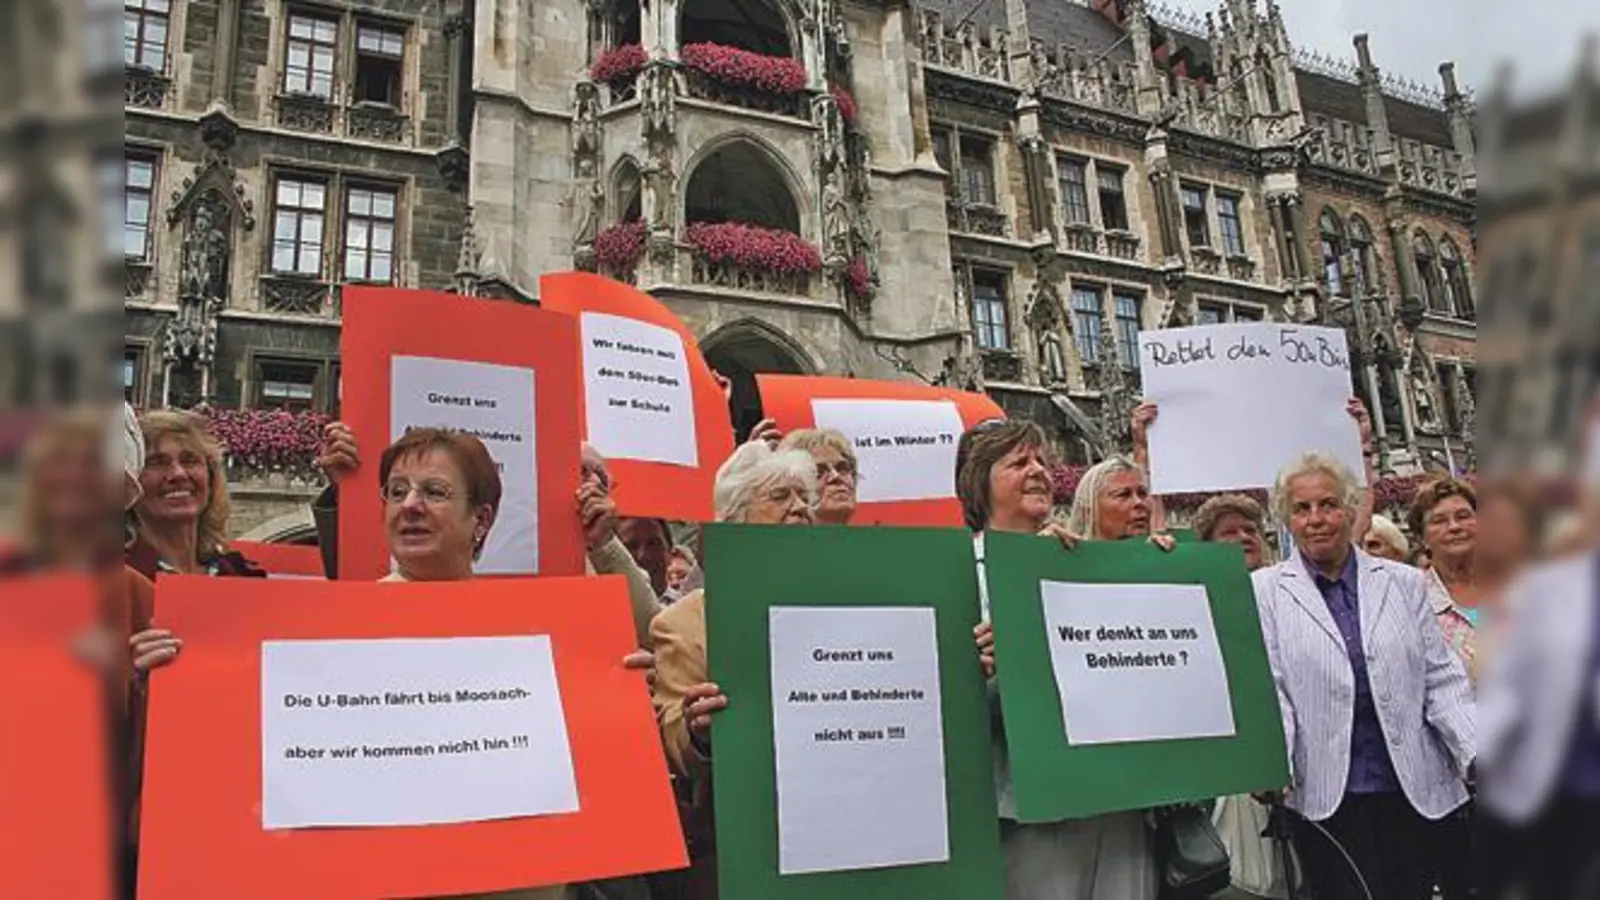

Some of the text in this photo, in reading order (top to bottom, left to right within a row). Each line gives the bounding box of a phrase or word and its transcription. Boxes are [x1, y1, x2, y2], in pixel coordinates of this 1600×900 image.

[592, 338, 676, 360] Wir fahren mit
[1144, 336, 1216, 367] Rettet
[1227, 335, 1271, 361] den
[597, 366, 625, 378] dem
[428, 392, 496, 408] Grenzt uns
[608, 398, 670, 413] zur Schule
[856, 433, 953, 448] ist im Winter ??
[1058, 625, 1199, 641] Wer denkt an uns
[812, 648, 894, 661] Grenzt uns
[1086, 650, 1189, 669] Behinderte ?
[284, 687, 531, 708] Die U-Bahn fährt bis Moosach-
[788, 688, 924, 702] Alte und Behinderte
[814, 727, 854, 741] nicht
[858, 730, 884, 740] aus
[285, 735, 529, 759] aber wir kommen nicht hin !!!
